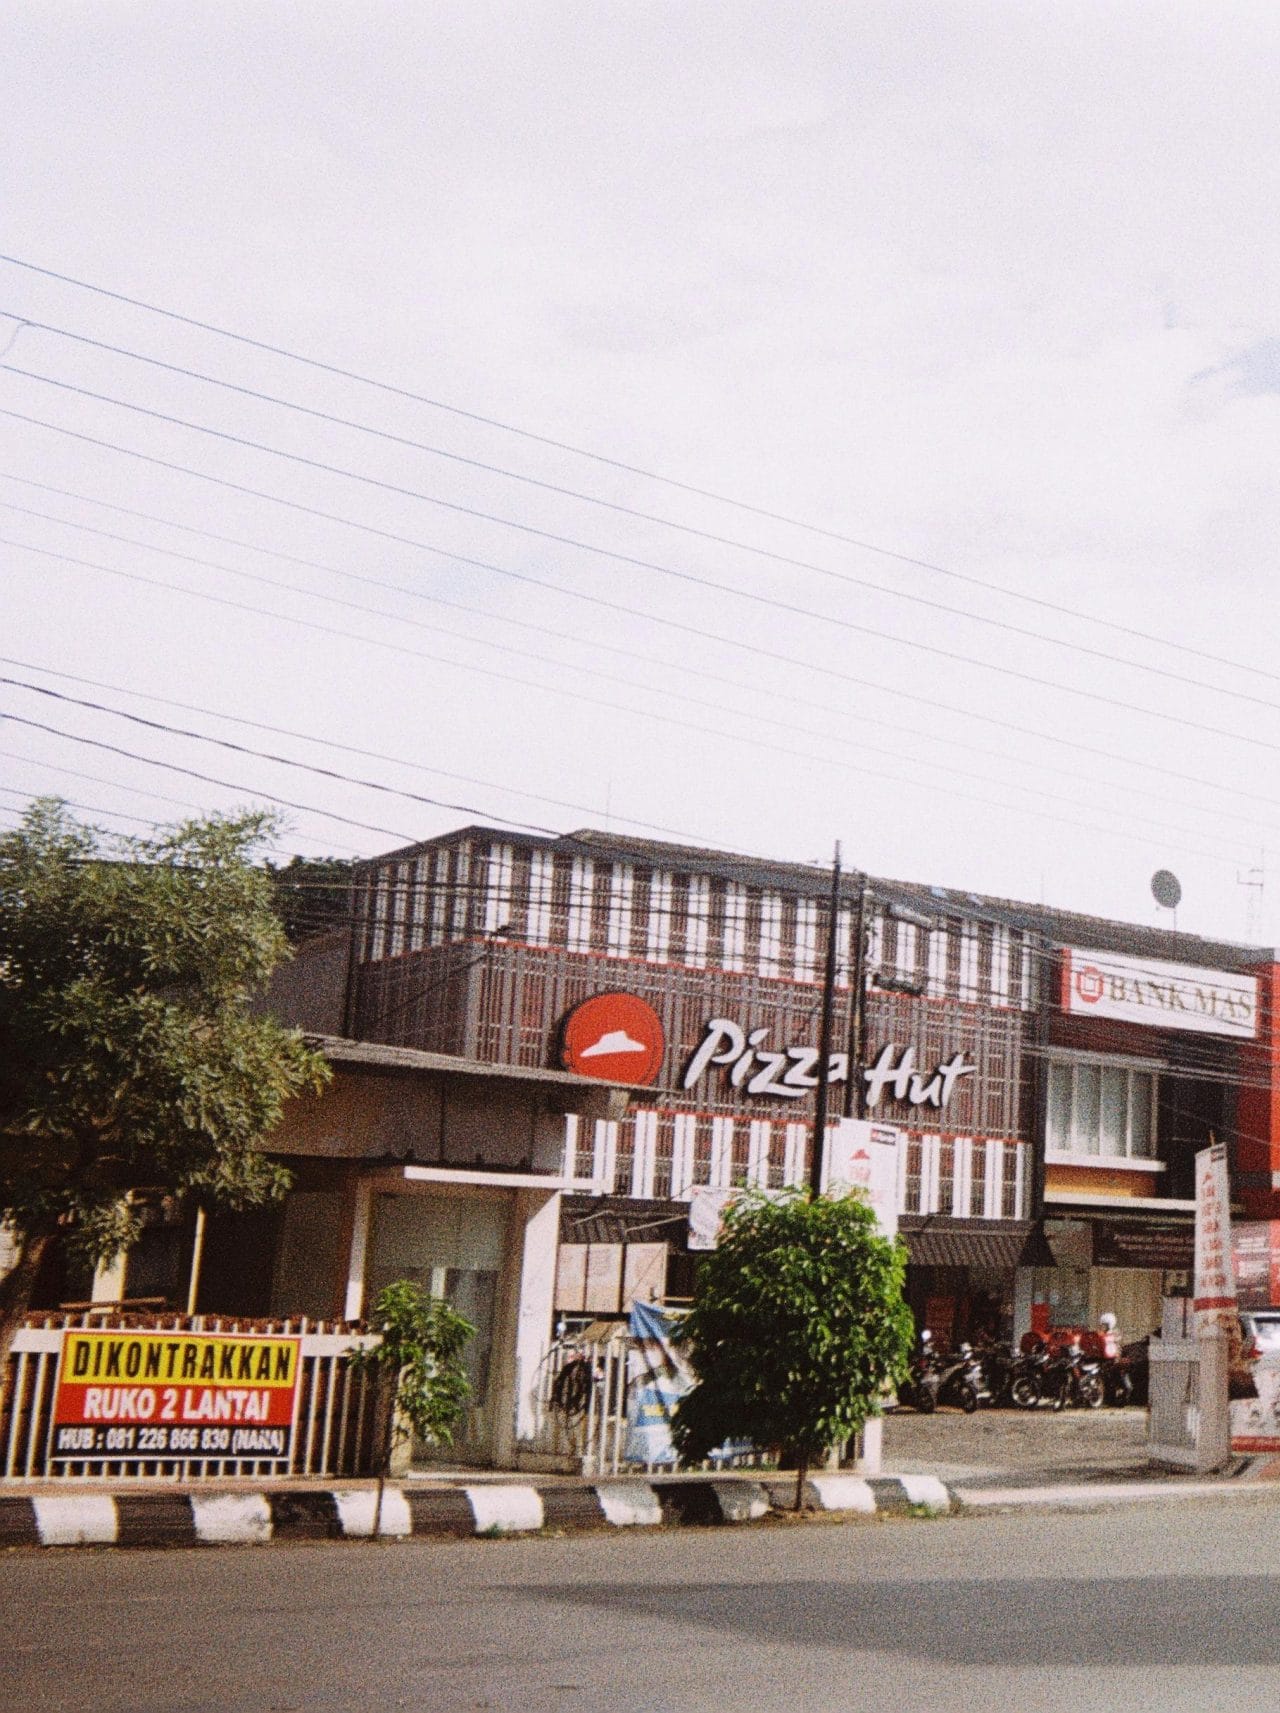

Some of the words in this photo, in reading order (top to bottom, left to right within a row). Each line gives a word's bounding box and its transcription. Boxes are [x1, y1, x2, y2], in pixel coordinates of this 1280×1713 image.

[1110, 976, 1188, 1011] BANK
[1193, 986, 1251, 1018] MAS
[684, 1018, 849, 1098] Pizza
[863, 1043, 977, 1107] Hut
[72, 1340, 291, 1381] DIKONTRAKKAN
[83, 1387, 156, 1420] RUKO
[160, 1388, 177, 1420] 2
[182, 1388, 271, 1421] LANTAI
[58, 1427, 95, 1450] HUB
[106, 1427, 136, 1450] 081
[137, 1427, 168, 1450] 226
